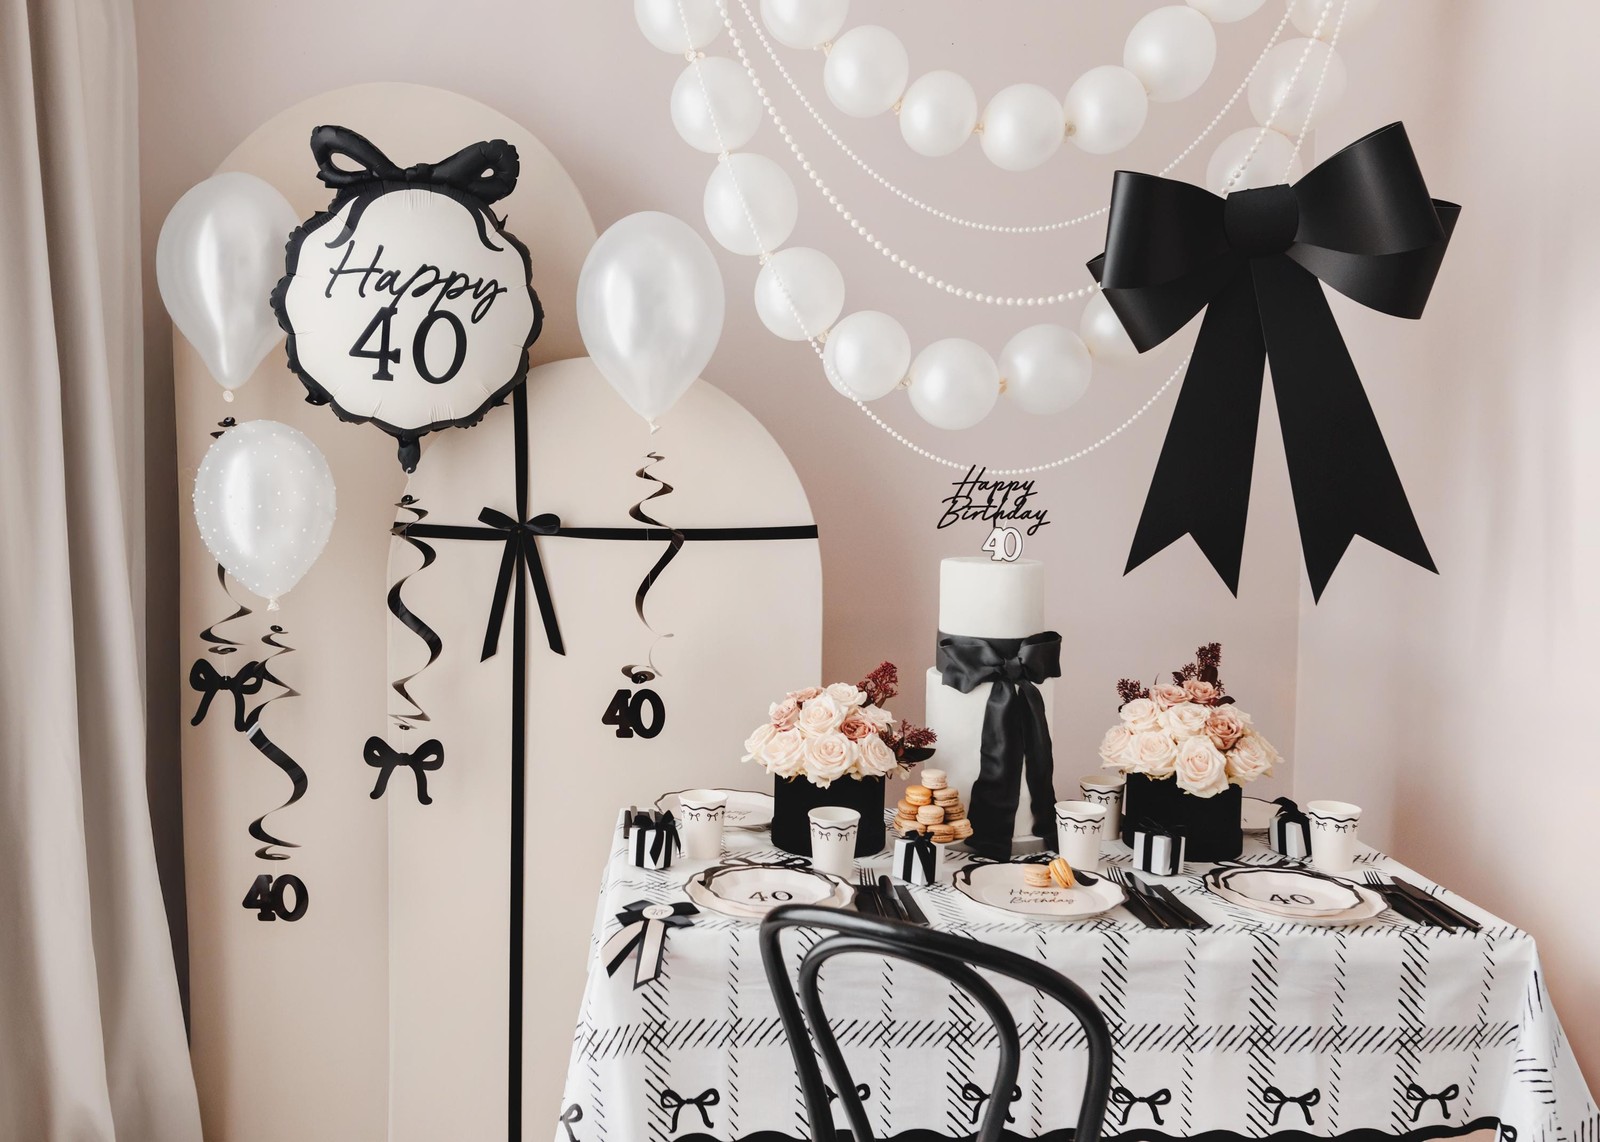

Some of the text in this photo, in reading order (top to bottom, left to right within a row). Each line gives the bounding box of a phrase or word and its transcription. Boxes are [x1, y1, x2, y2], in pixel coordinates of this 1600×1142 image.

[324, 239, 508, 324] Happy
[348, 306, 468, 385] 40
[951, 464, 1038, 504] Happy
[936, 495, 1051, 536] Birthday
[980, 526, 1024, 562] 40
[601, 688, 666, 739] 40
[241, 873, 309, 922] 40
[748, 890, 794, 902] 40
[1009, 888, 1061, 897] Happy
[1009, 896, 1075, 905] Birthday
[1269, 893, 1316, 905] 40
